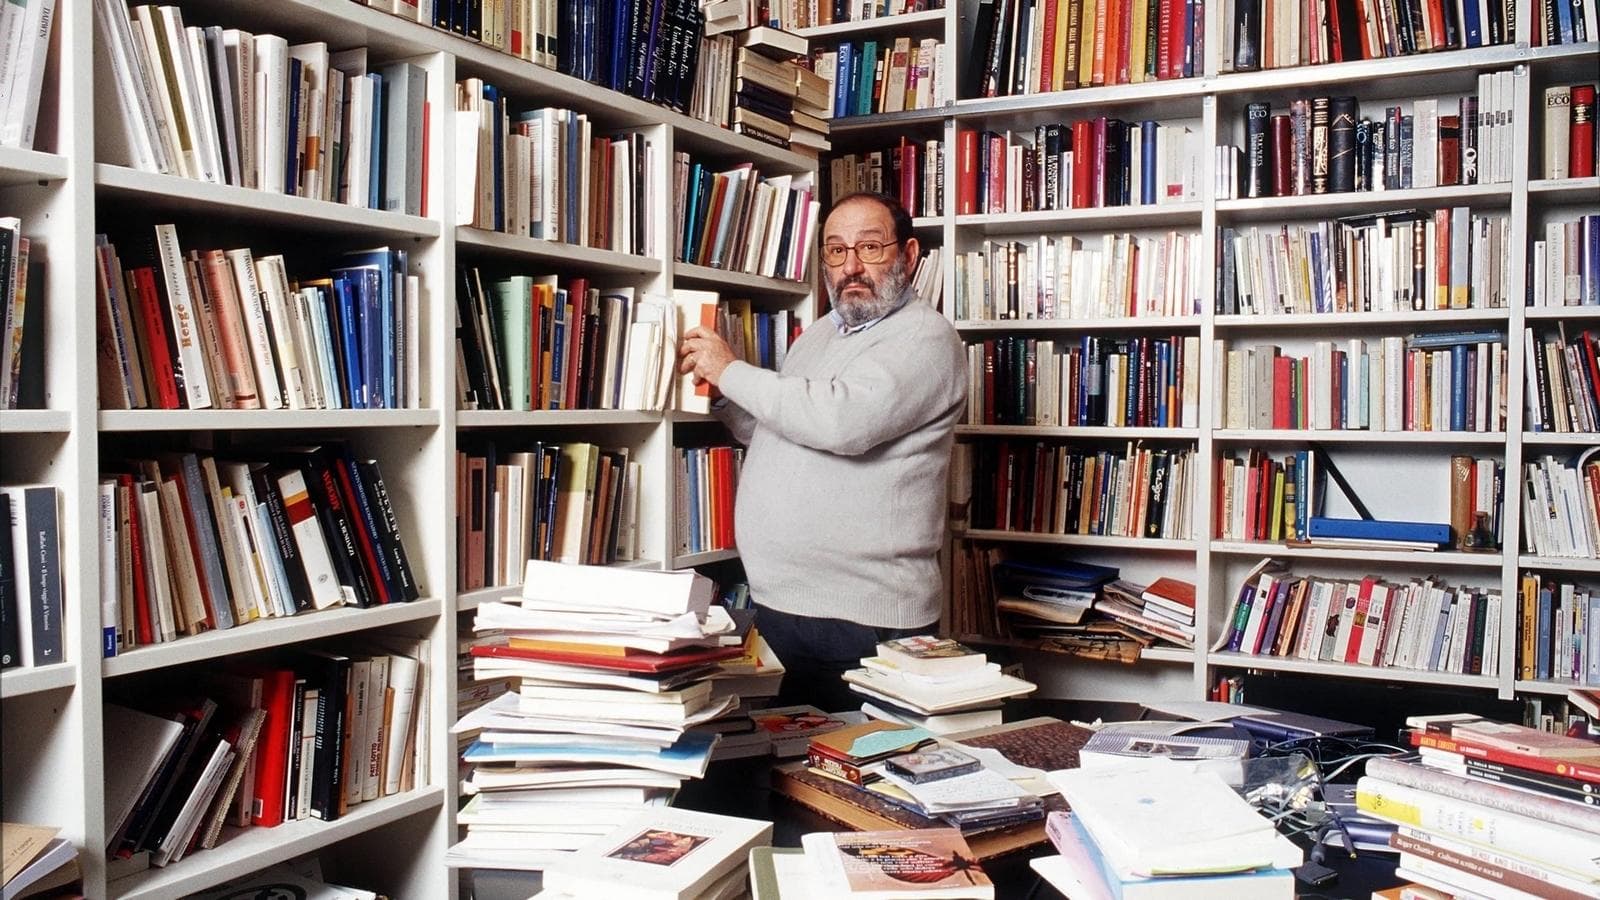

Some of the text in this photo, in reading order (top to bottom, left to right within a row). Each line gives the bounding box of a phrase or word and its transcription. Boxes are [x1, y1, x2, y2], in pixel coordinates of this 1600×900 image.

[39, 7, 50, 39] DARWIN
[1070, 4, 1078, 26] FIGURATA
[668, 26, 682, 75] Umberto Eco
[680, 30, 694, 79] Umberto Eco
[1249, 110, 1267, 119] ECO
[1548, 97, 1569, 105] ECO
[171, 272, 181, 296] Pierre
[174, 303, 193, 349] Hergé
[322, 470, 341, 510] WOODY
[377, 480, 400, 541] CALVINO
[340, 526, 354, 557] BENDAZZI
[1396, 838, 1413, 851] Roger
[1494, 856, 1508, 868] AND
